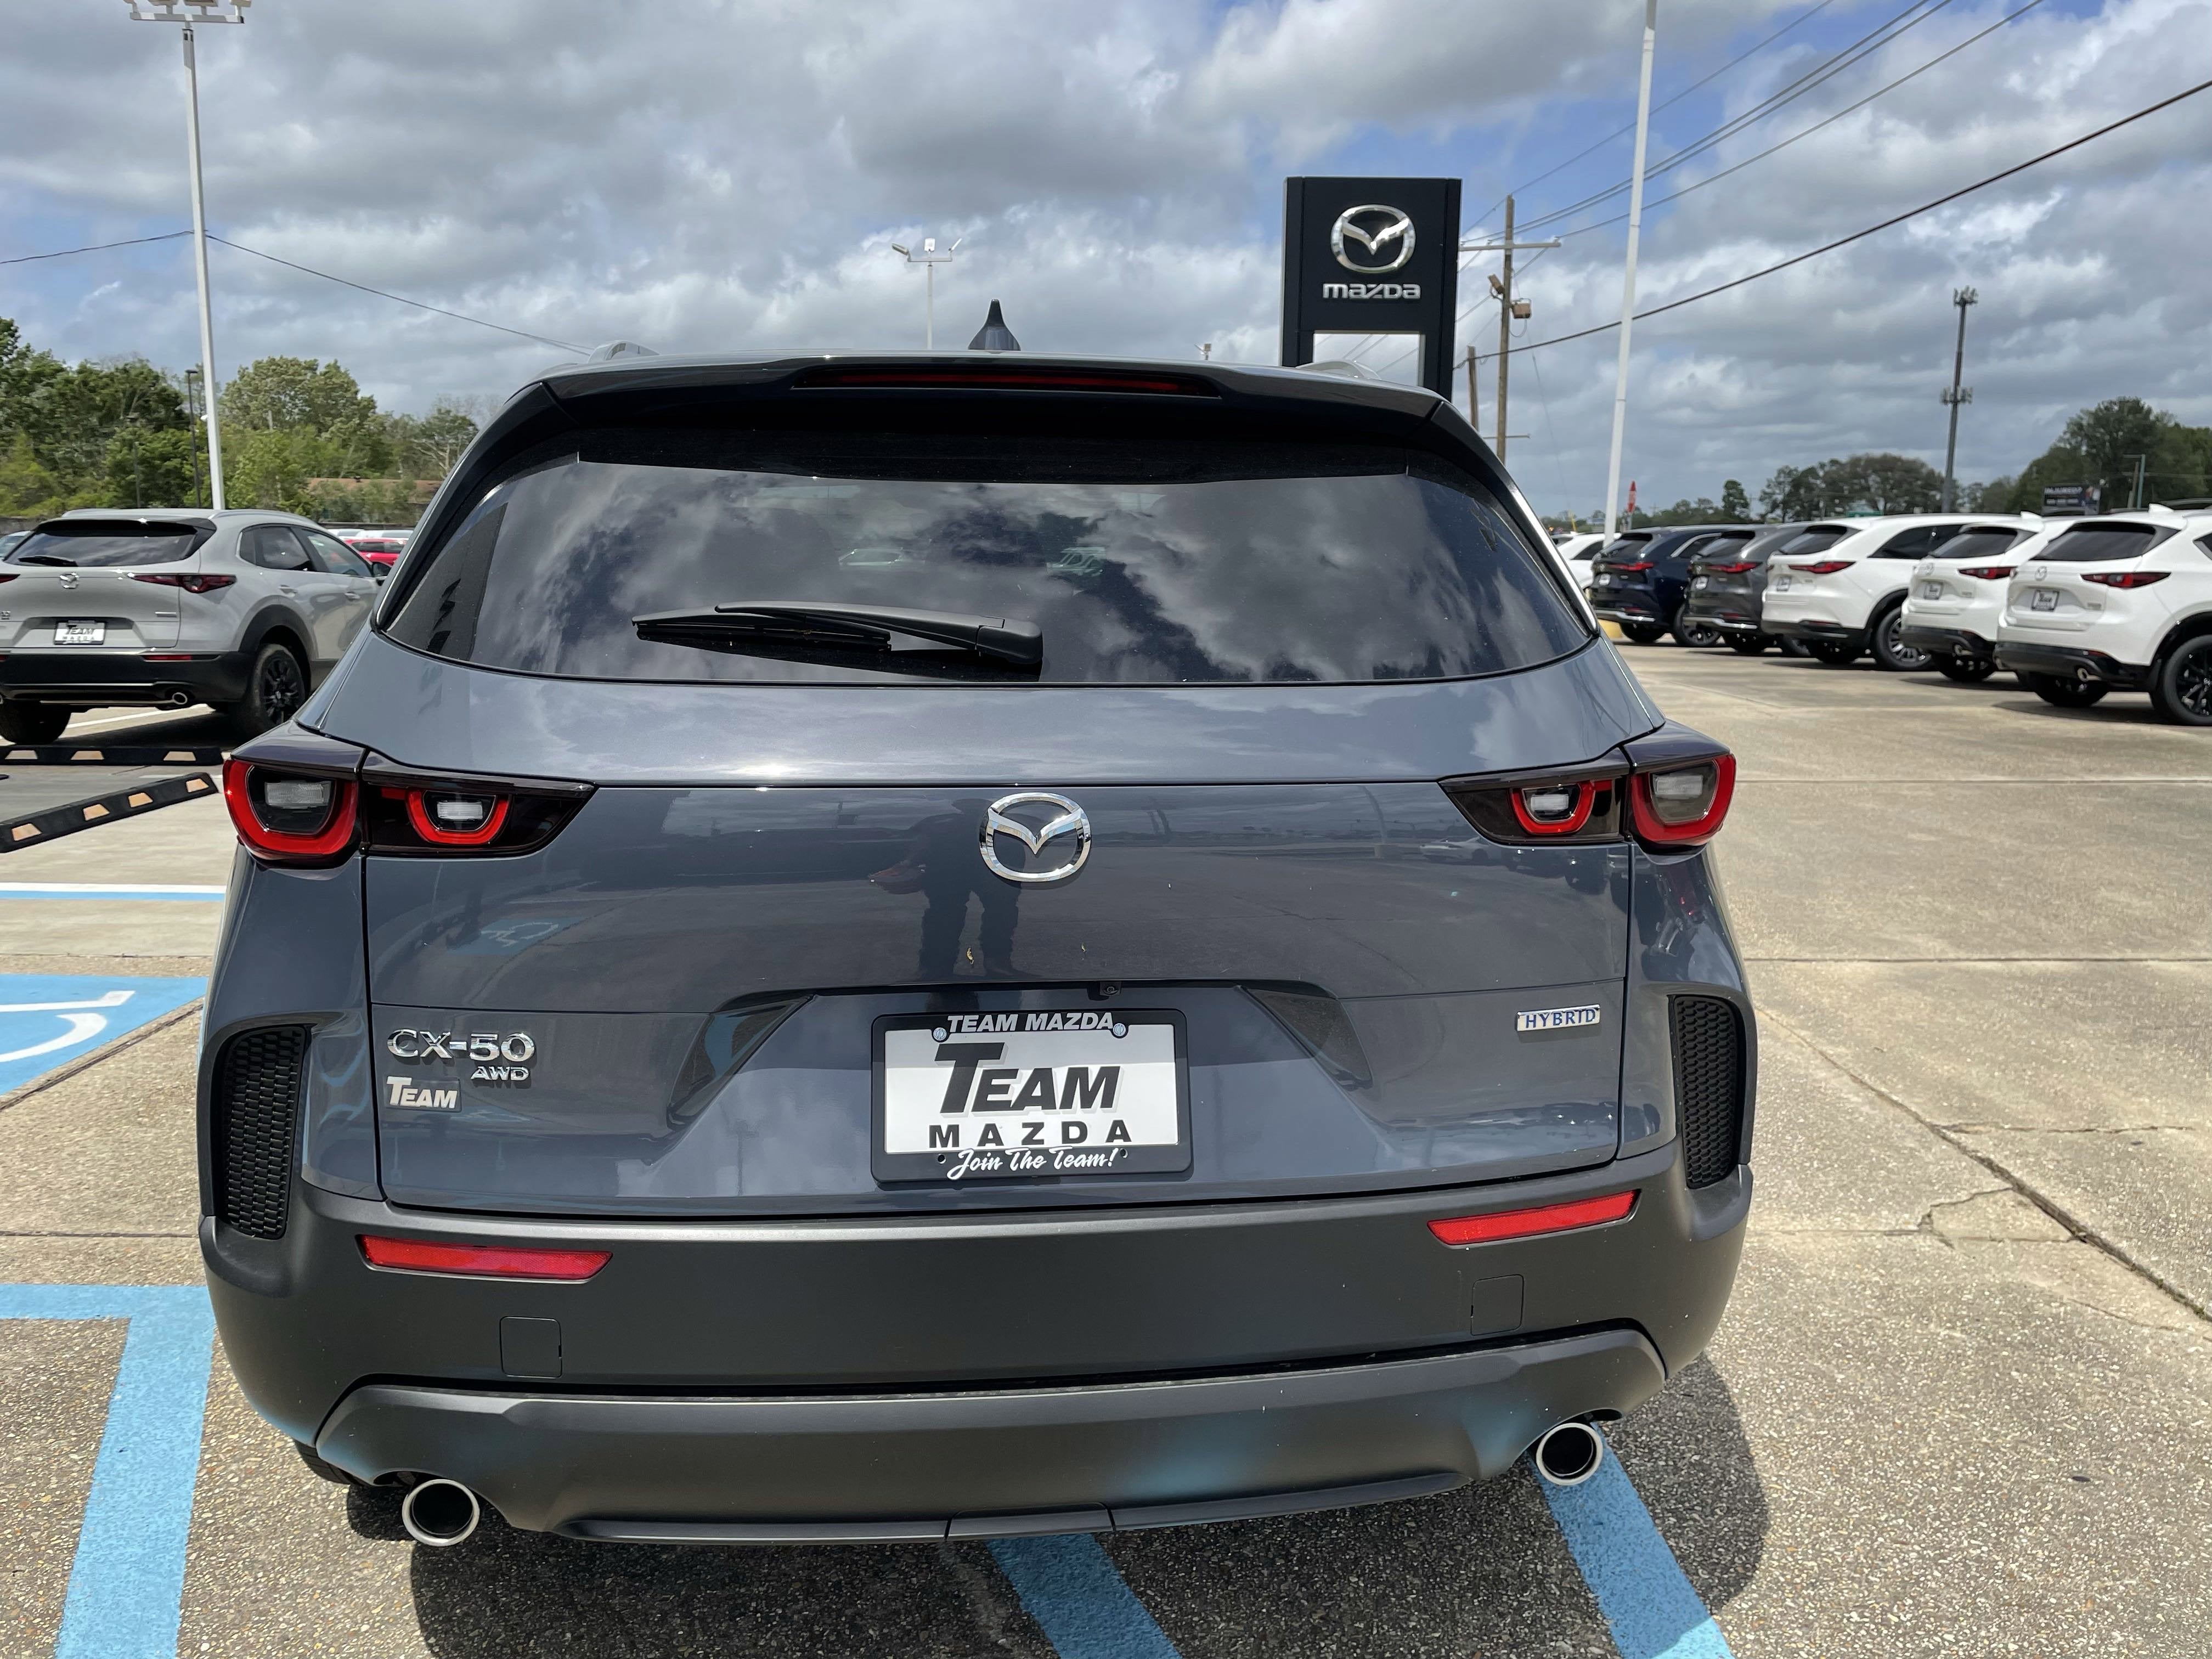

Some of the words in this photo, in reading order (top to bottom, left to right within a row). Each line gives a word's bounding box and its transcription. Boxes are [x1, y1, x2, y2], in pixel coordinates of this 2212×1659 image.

[947, 1014, 1017, 1033] TEAM
[1025, 1012, 1114, 1032] MAZDA
[1525, 1008, 1596, 1029] HYBRID
[386, 1029, 535, 1062] CX-50
[470, 1066, 529, 1081] AWD
[934, 1042, 1122, 1116] TEAM
[386, 1076, 458, 1109] TEAM
[929, 1120, 1132, 1148] MAZDA
[947, 1148, 1003, 1181] Join
[1005, 1147, 1047, 1171] The
[1052, 1146, 1119, 1170] Team!
